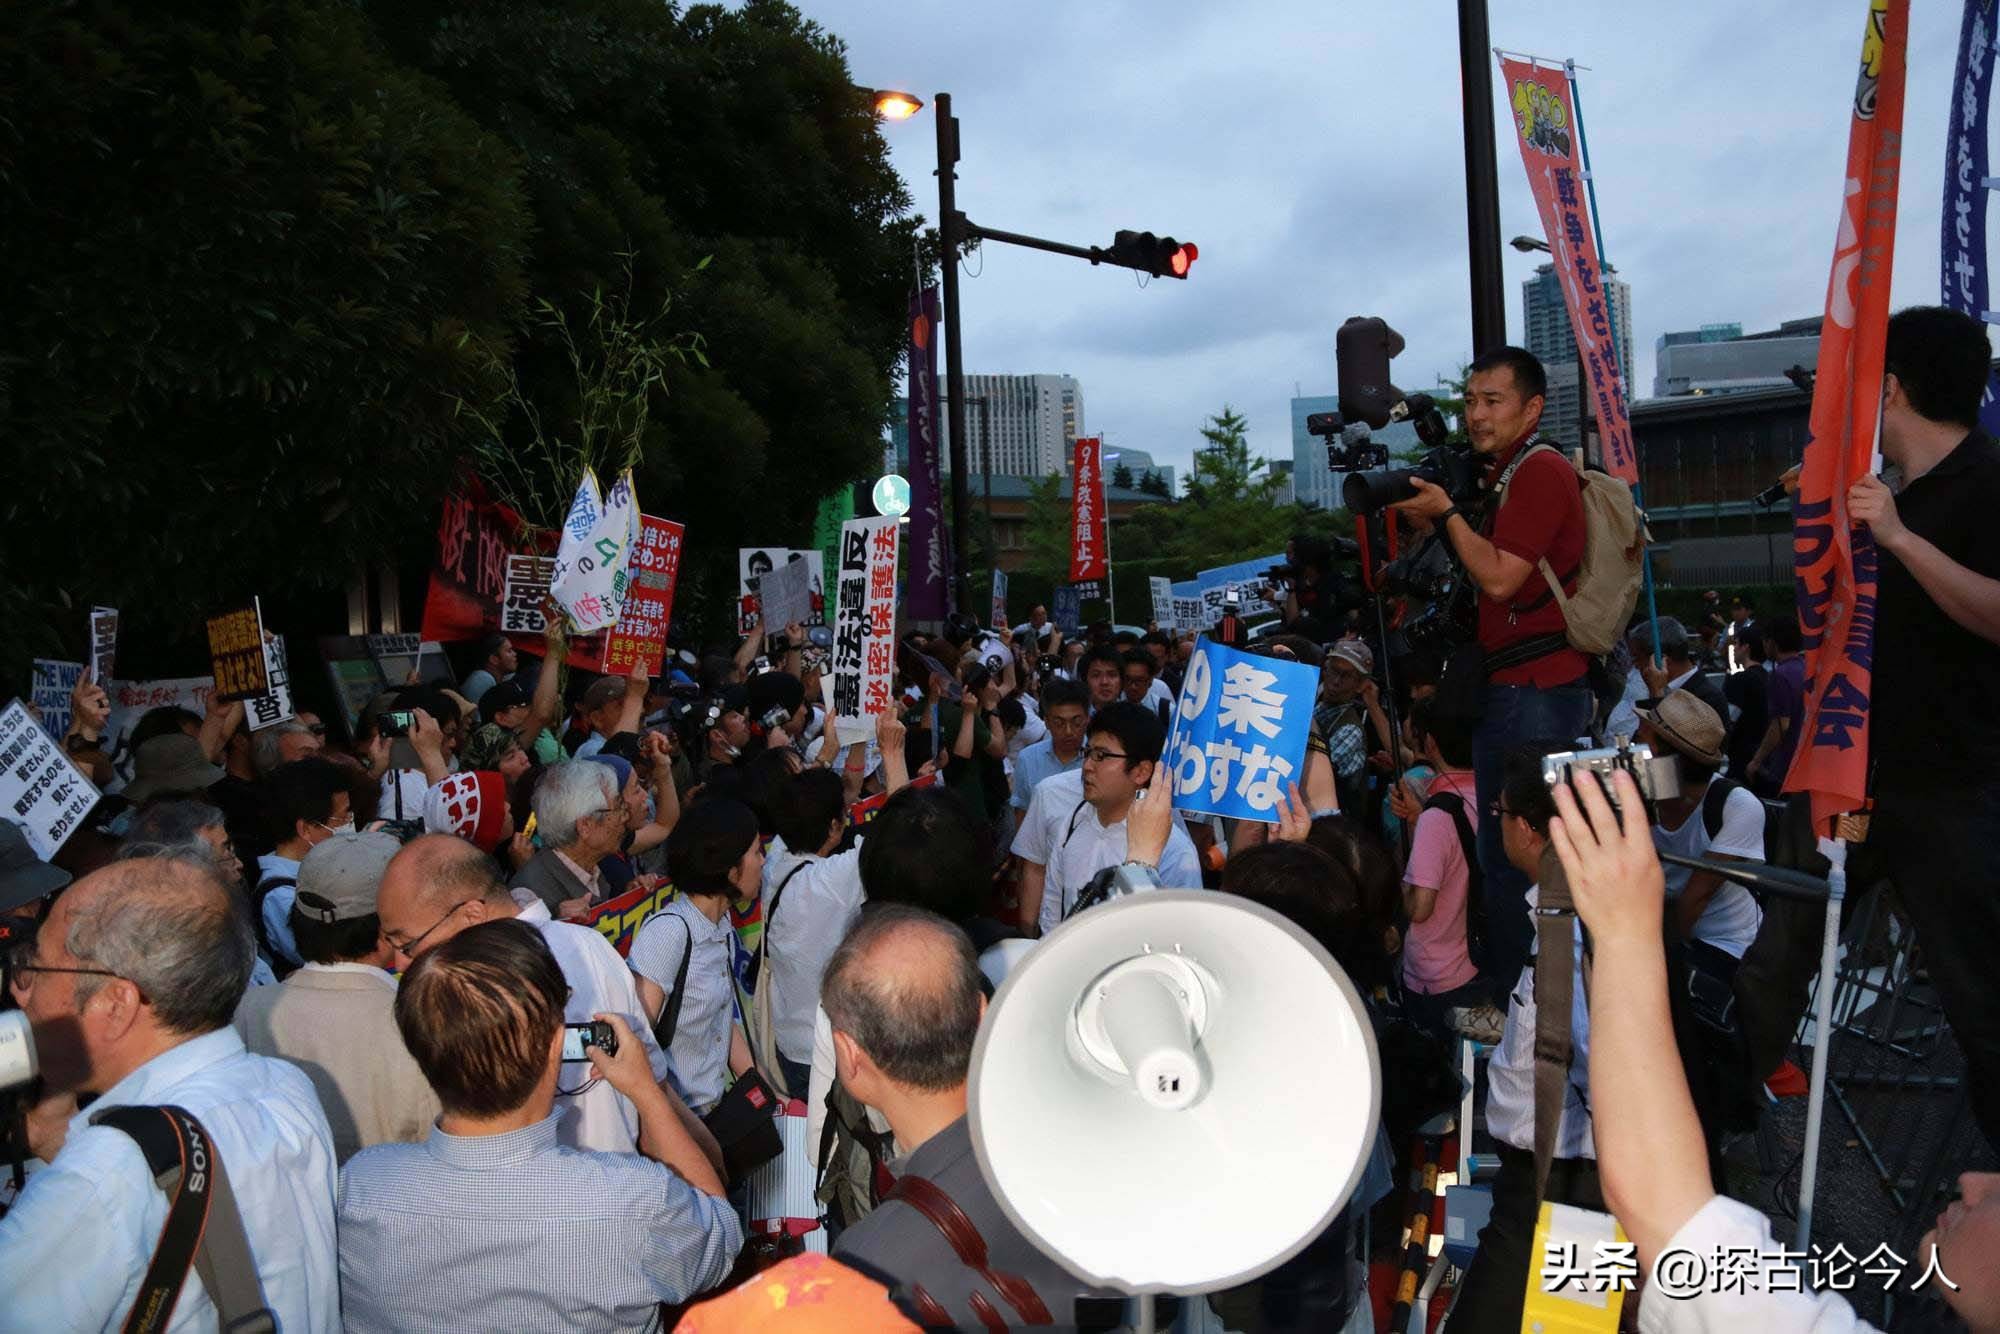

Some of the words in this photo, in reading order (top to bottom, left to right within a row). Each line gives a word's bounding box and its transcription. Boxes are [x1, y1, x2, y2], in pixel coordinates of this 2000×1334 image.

[864, 525, 898, 716] 秘密保護法
[1181, 650, 1288, 739] 9条
[182, 1115, 207, 1193] SONY
